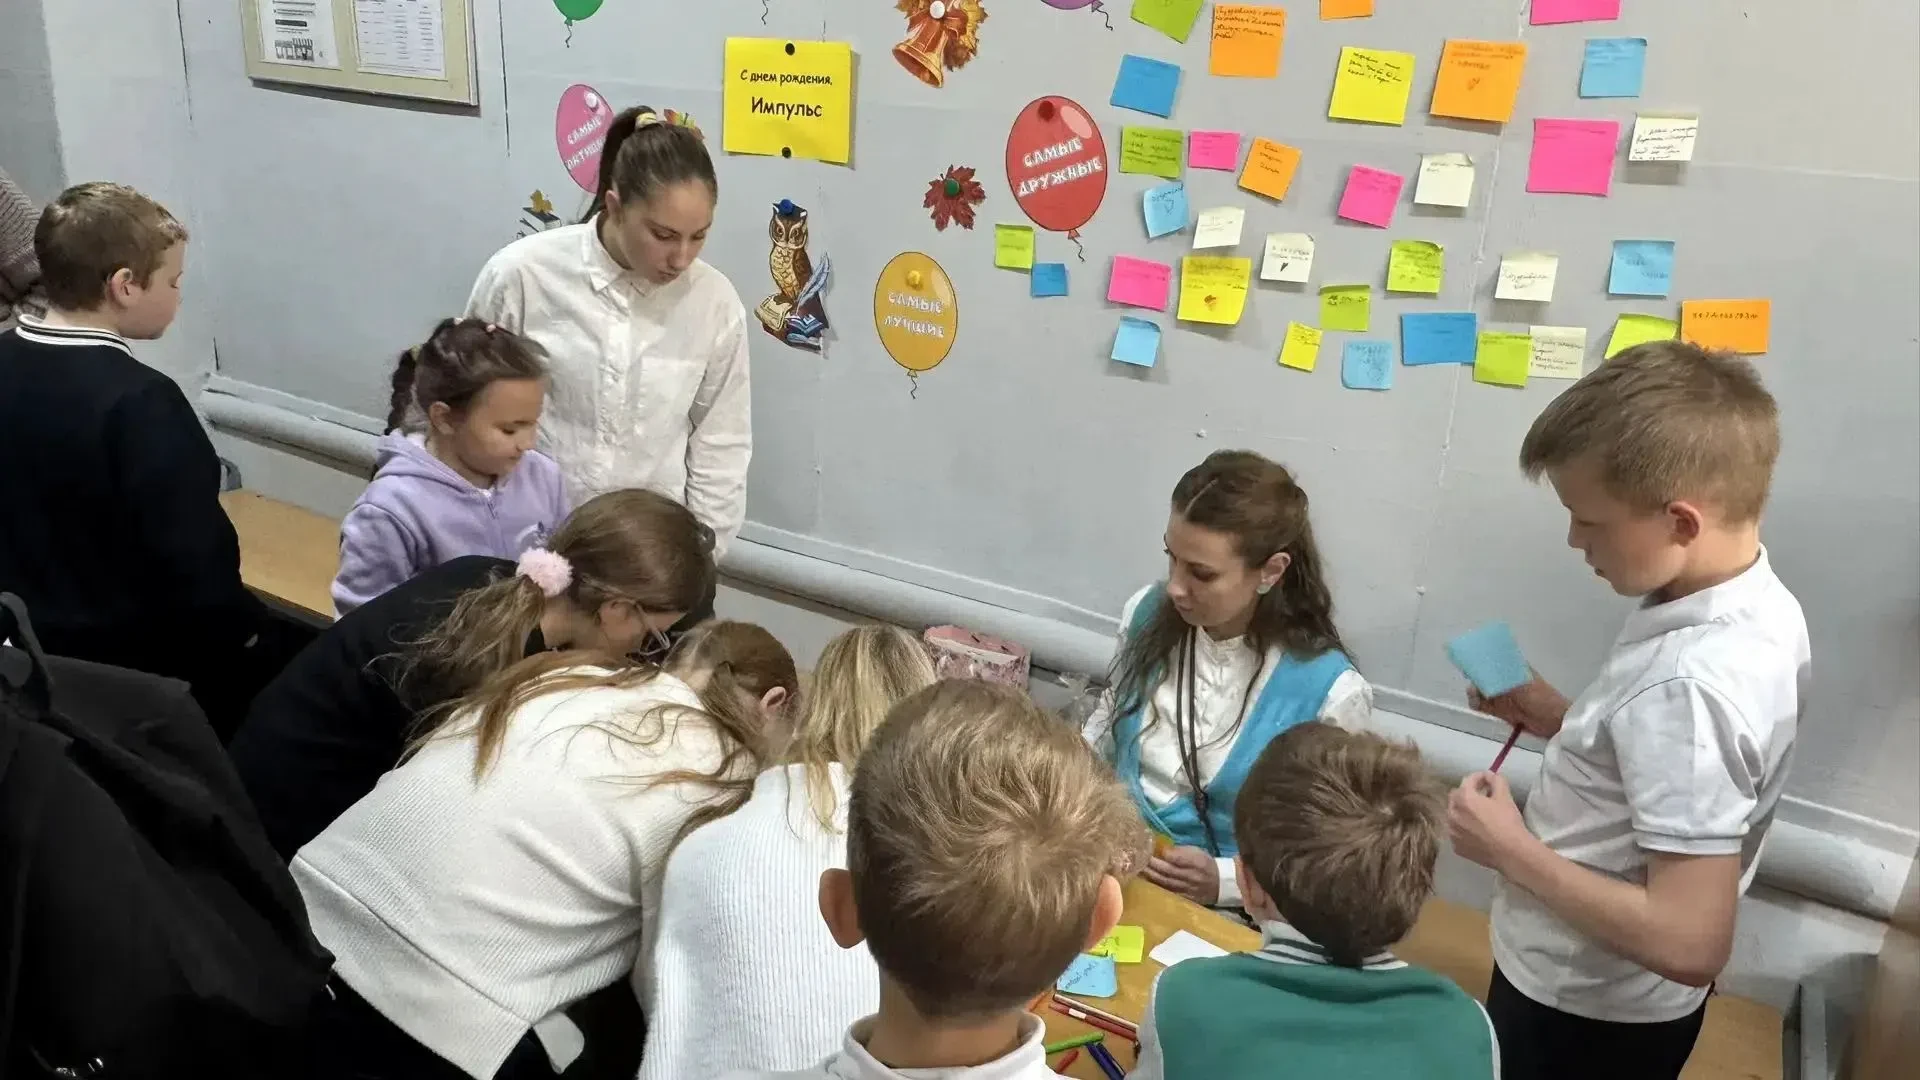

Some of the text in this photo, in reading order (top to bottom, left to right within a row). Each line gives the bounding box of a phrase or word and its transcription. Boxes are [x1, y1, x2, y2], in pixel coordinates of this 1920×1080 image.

[740, 69, 833, 87] С днем рождения,
[751, 96, 823, 121] Импульс
[567, 116, 603, 145] САМЫЕ
[1023, 137, 1084, 168] САМЫЕ
[1016, 156, 1104, 198] ДРУЖНЫЕ
[888, 291, 945, 315] САМЫЕ
[884, 314, 945, 339] ЛУЧШИЕ
